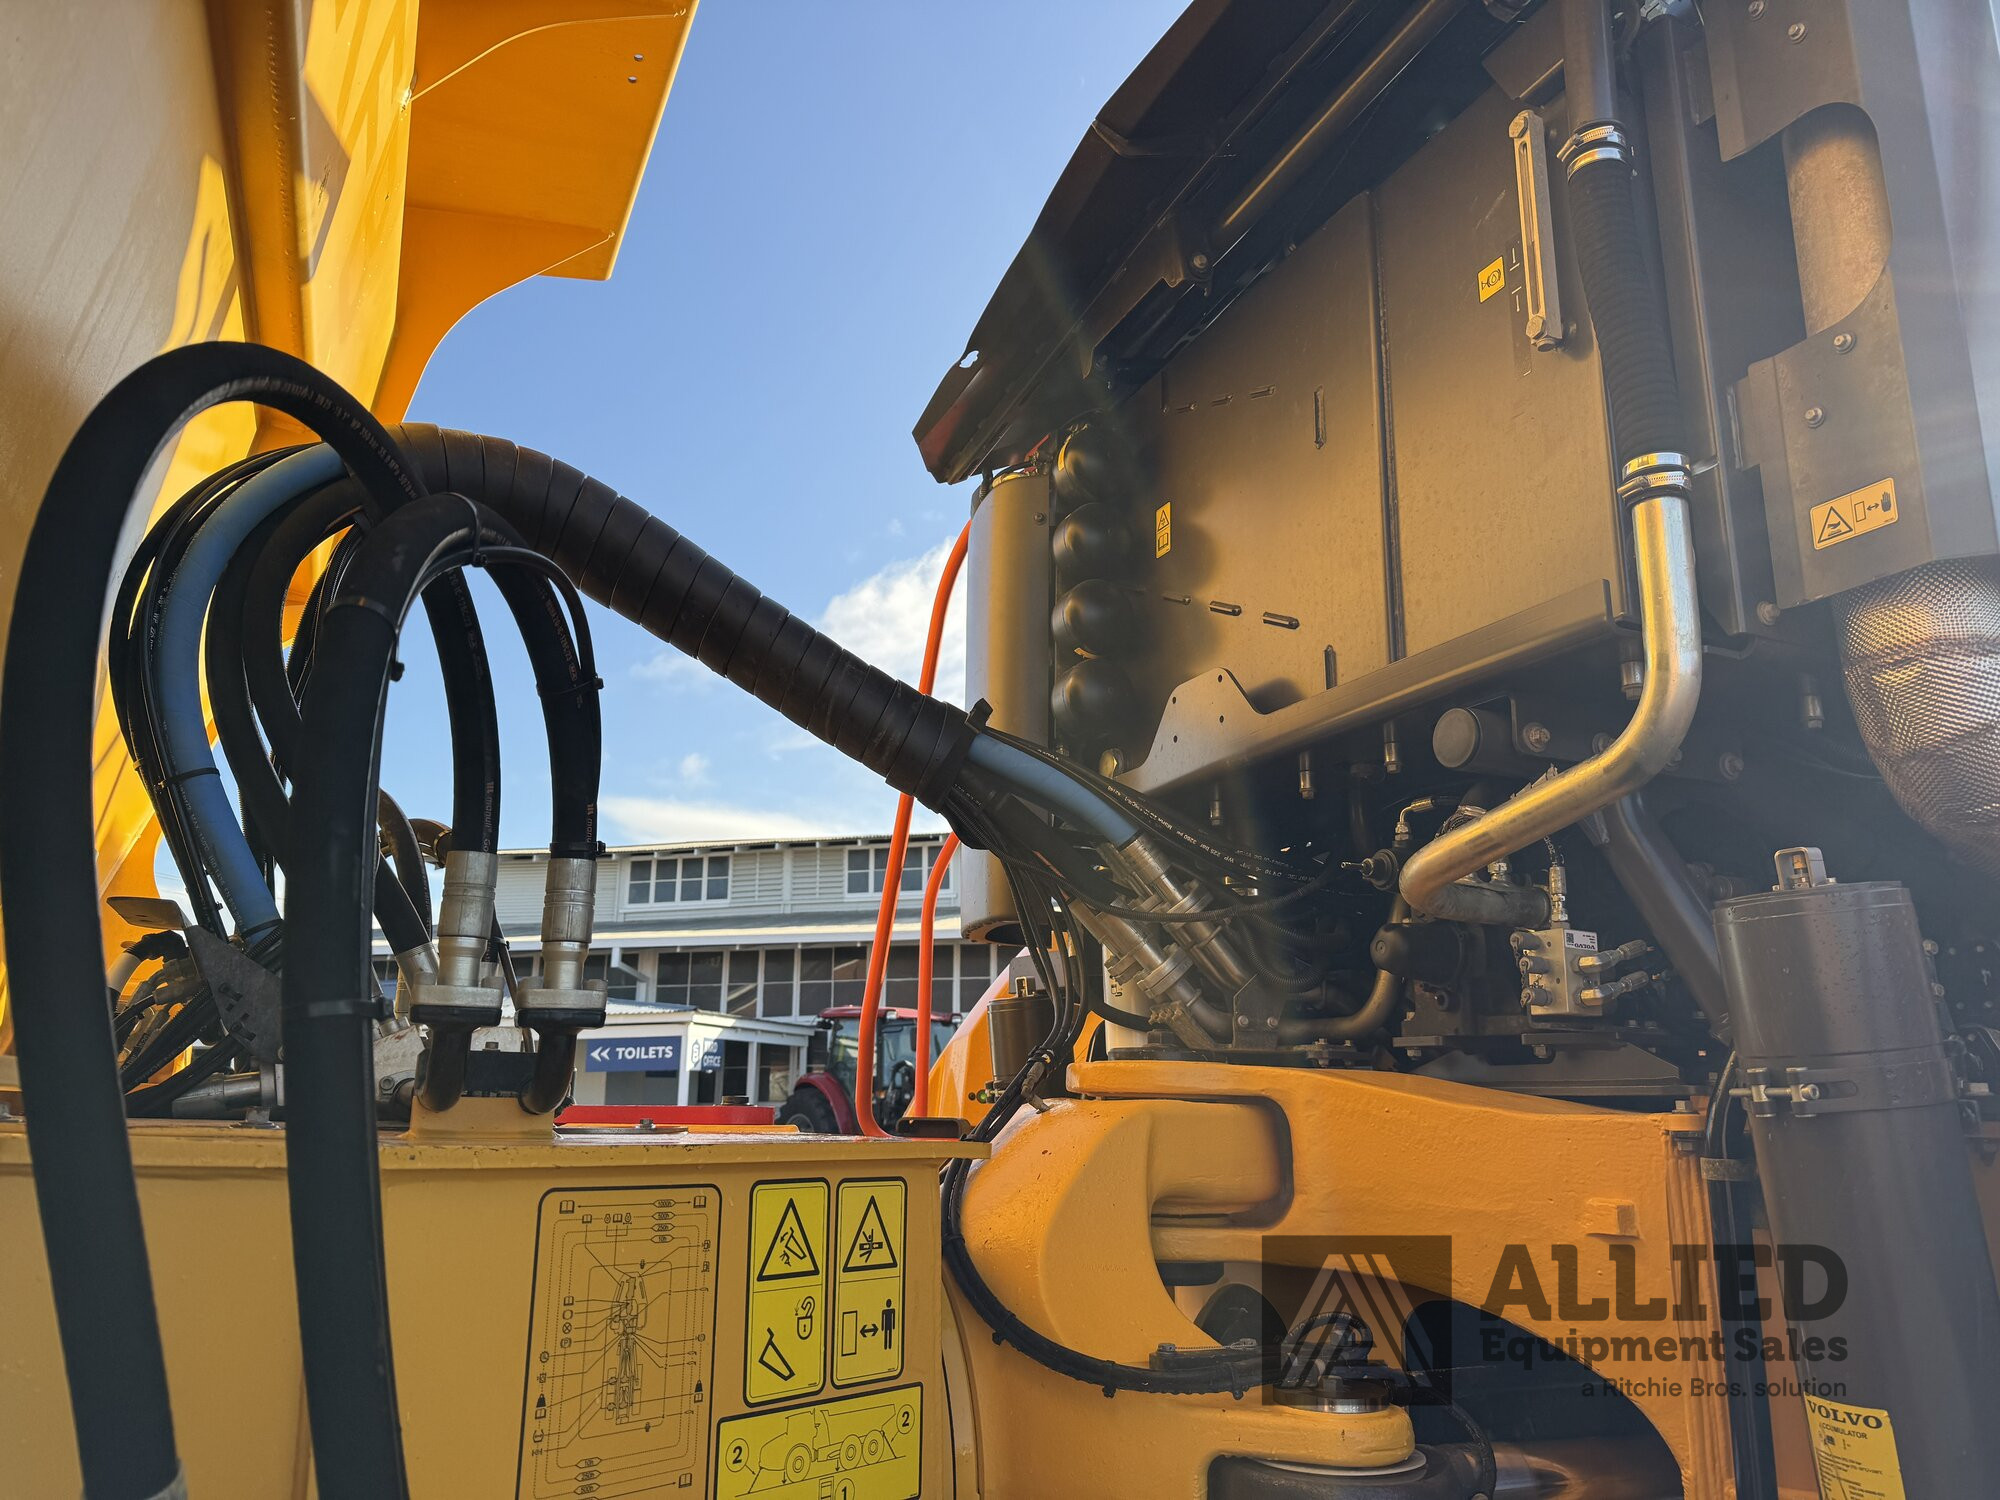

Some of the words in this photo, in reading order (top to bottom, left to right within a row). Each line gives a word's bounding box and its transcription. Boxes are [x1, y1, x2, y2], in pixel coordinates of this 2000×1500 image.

[616, 1046, 673, 1060] TOILETS
[900, 1411, 911, 1428] 2
[1807, 1399, 1883, 1429] VOLVO
[732, 1446, 743, 1465] 2
[841, 1486, 848, 1500] 1
